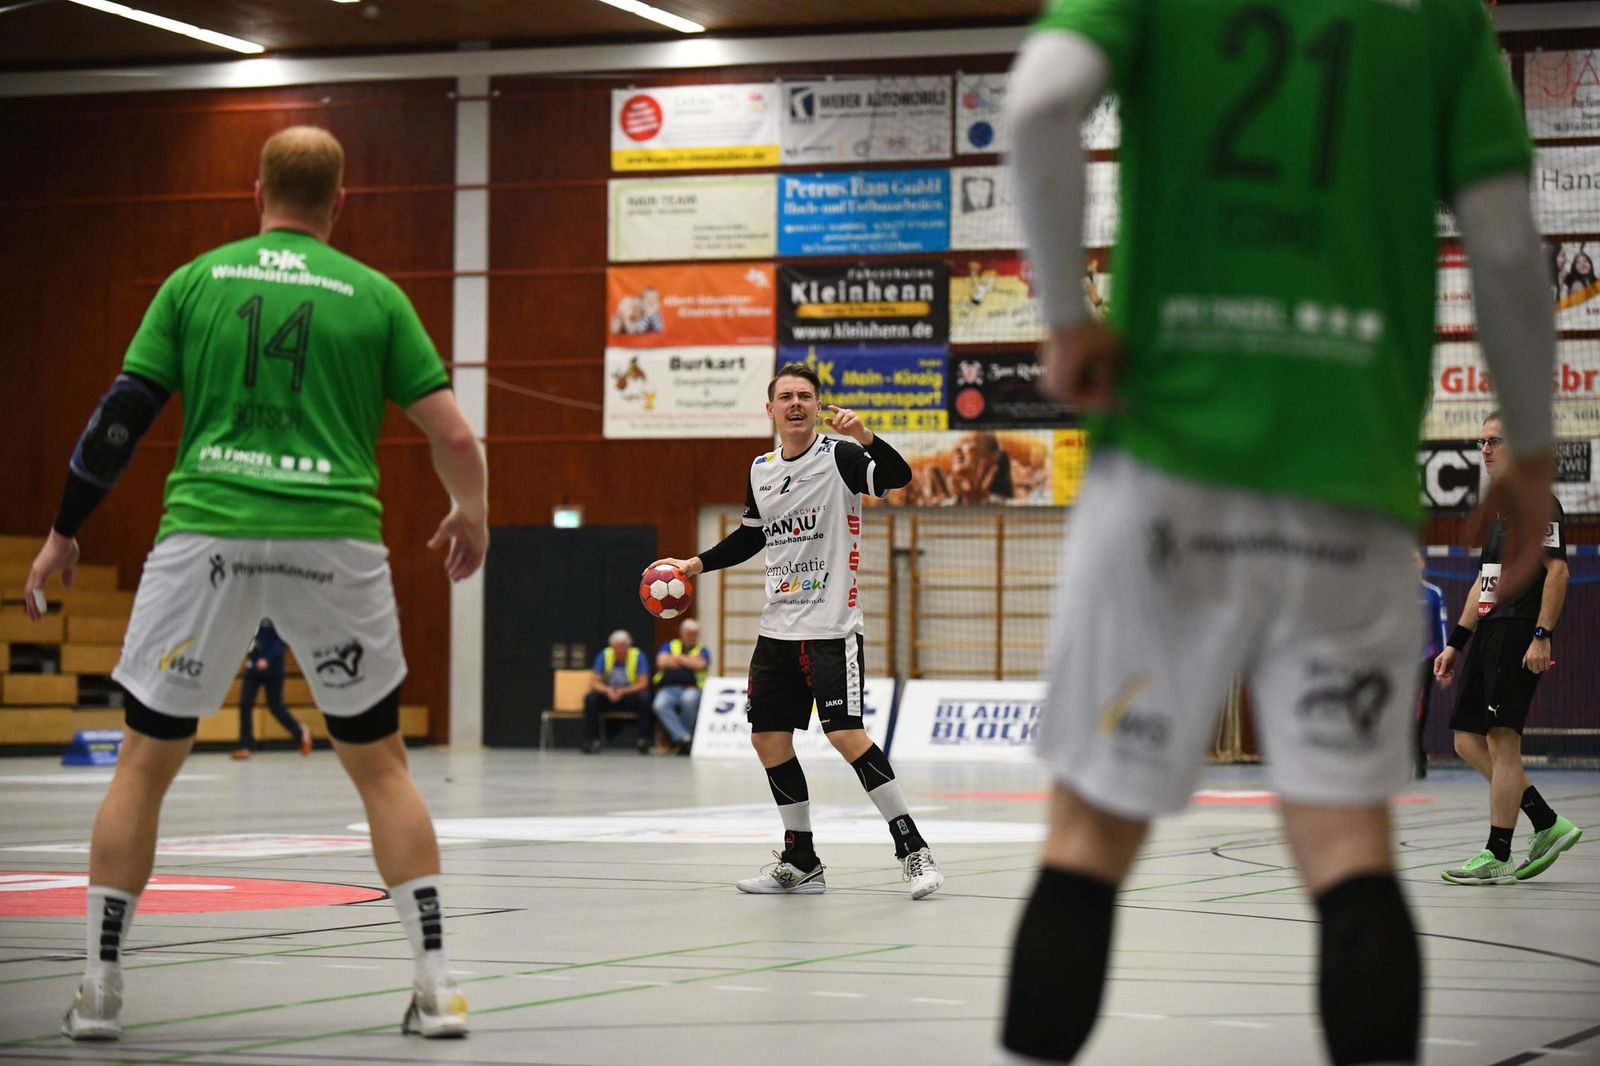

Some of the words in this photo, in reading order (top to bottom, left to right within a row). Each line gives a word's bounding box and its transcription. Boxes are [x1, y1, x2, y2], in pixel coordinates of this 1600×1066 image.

[1210, 8, 1354, 190] 21
[791, 280, 934, 303] Kleinhenn
[236, 294, 313, 393] 14
[670, 357, 746, 371] Burkart
[780, 475, 791, 494] 2
[825, 699, 844, 707] JAKO
